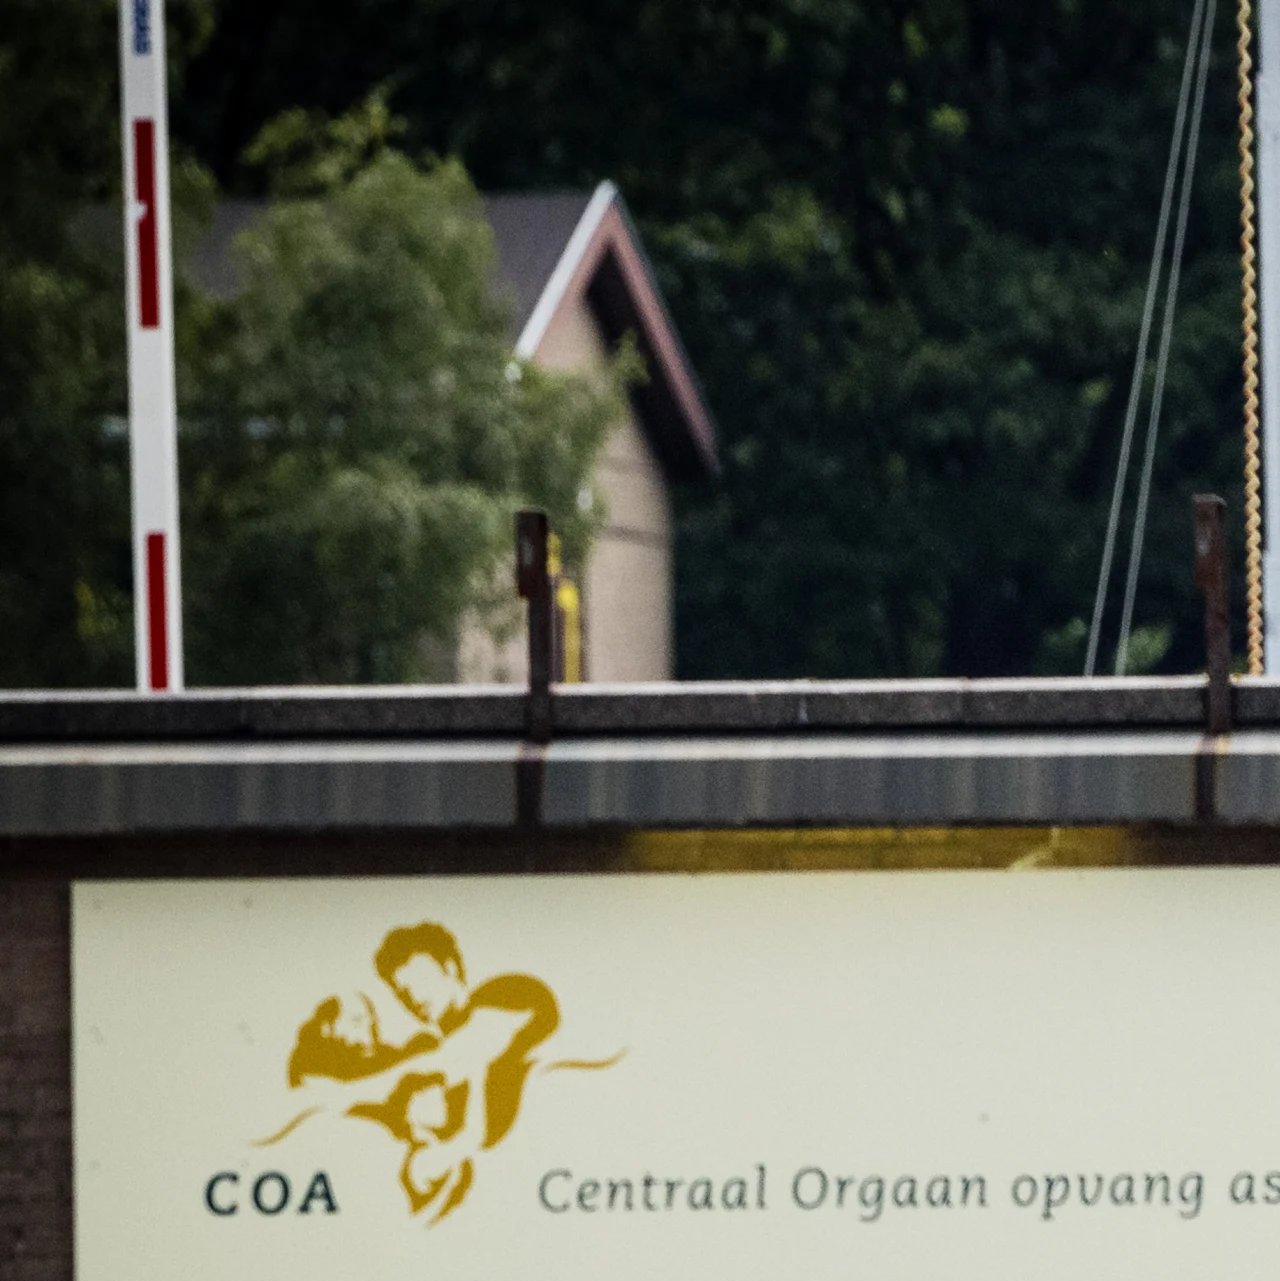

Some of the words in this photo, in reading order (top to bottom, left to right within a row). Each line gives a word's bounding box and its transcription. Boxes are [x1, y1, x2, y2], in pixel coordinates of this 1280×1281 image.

[203, 1170, 340, 1217] COA
[538, 1164, 768, 1214] Centraal
[791, 1166, 988, 1223] Orgaan
[1010, 1171, 1204, 1221] opvang
